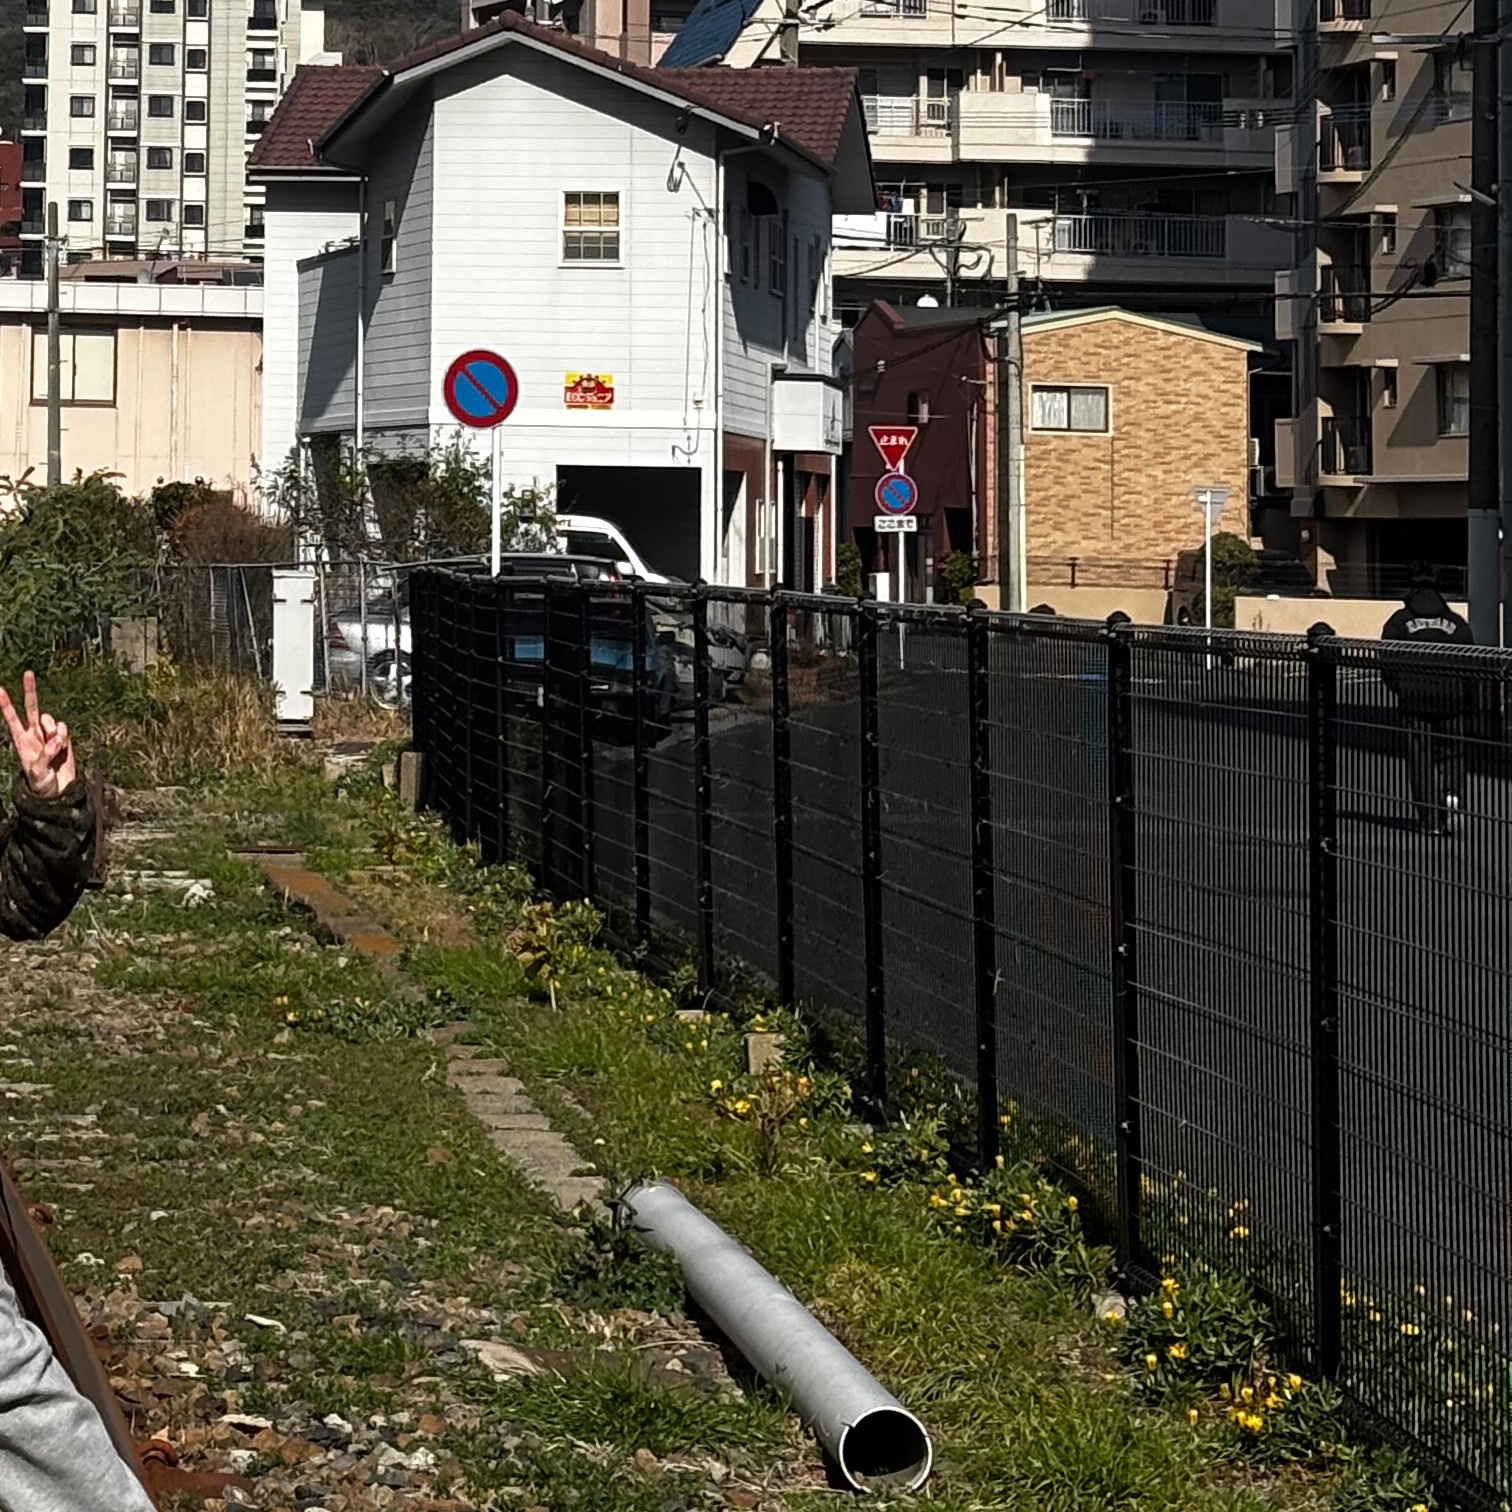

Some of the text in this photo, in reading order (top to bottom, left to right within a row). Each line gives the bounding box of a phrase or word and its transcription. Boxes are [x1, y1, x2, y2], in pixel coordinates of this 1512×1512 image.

[879, 434, 909, 446] 止まれ
[877, 518, 915, 530] ここまで
